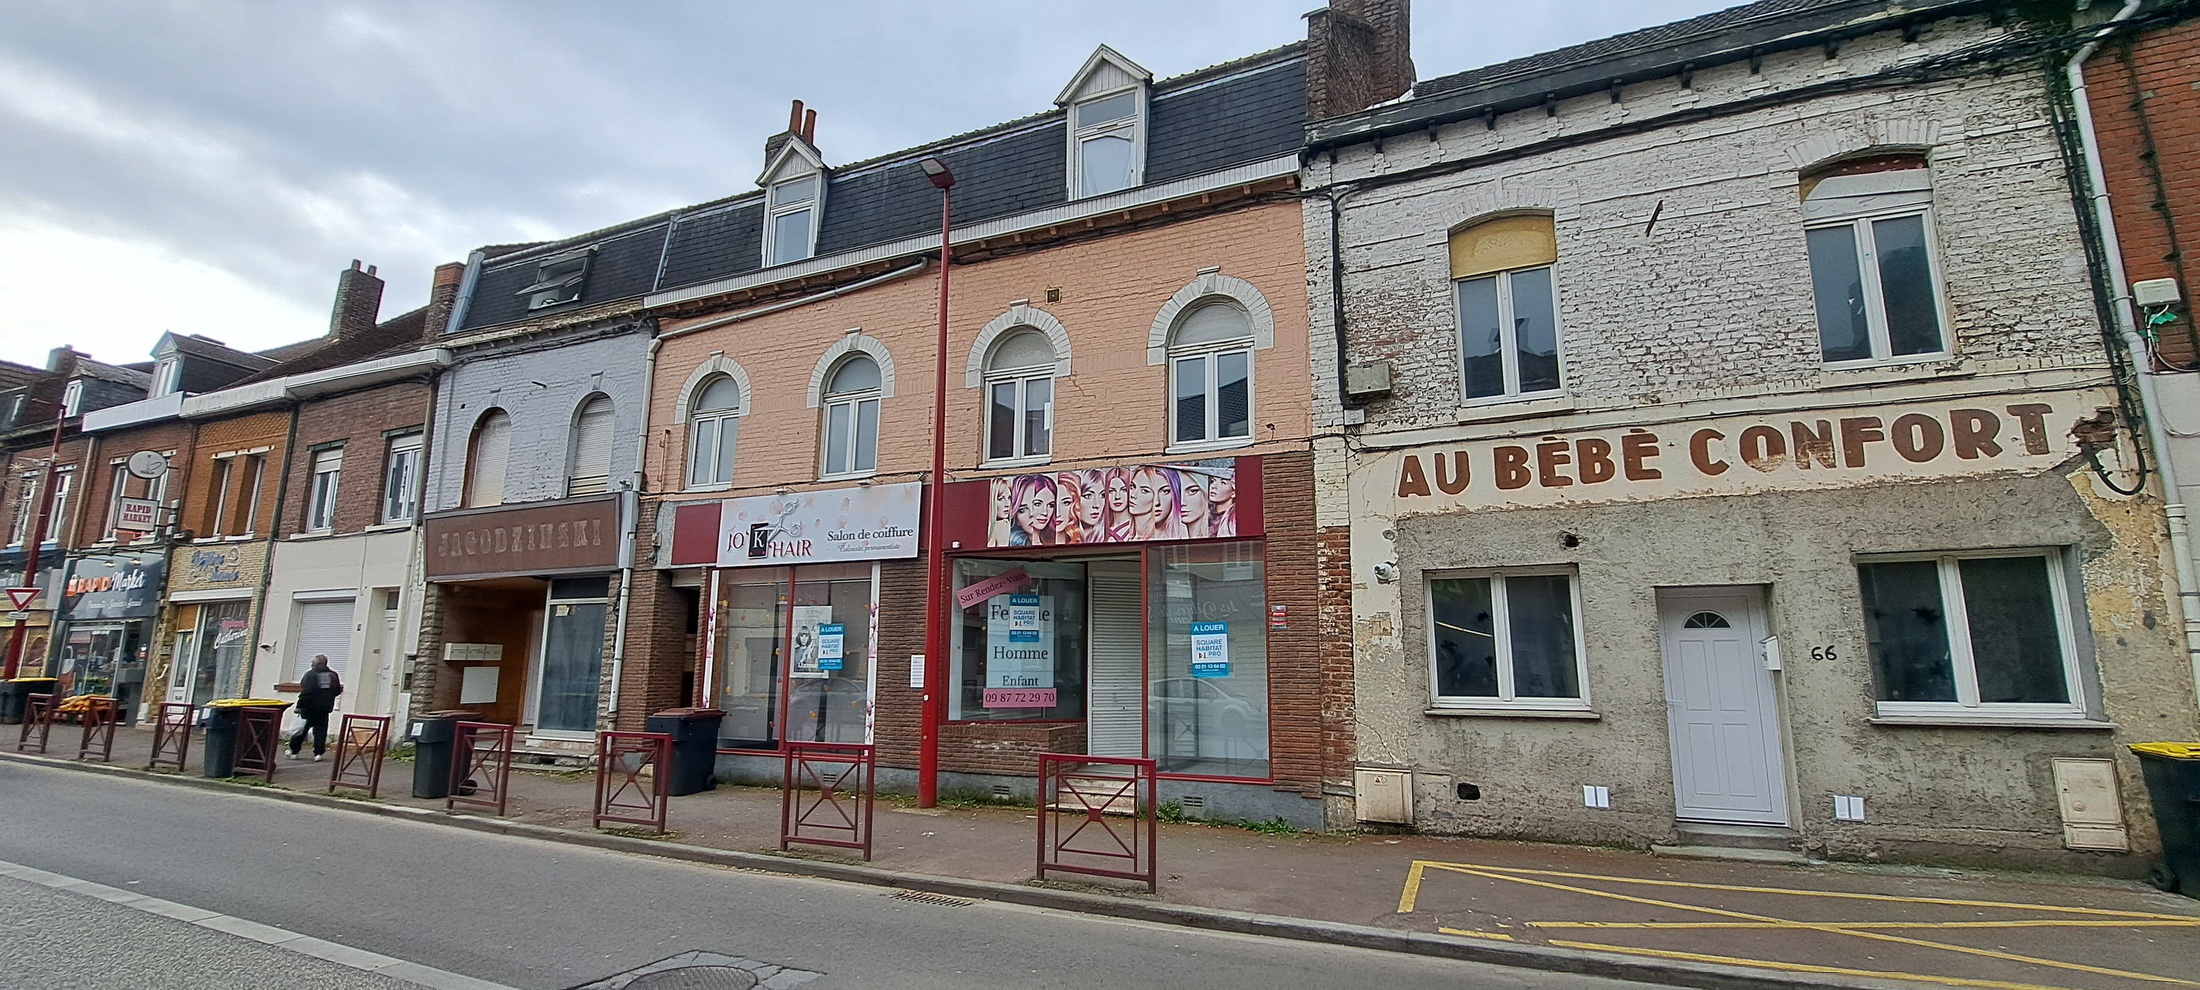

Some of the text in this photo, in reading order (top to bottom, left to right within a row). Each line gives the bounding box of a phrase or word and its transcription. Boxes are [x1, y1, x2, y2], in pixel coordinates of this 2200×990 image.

[1398, 450, 1471, 497] AU
[1689, 403, 2054, 476] CONFORT
[125, 503, 152, 514] RAPID
[122, 512, 152, 524] MARKET
[437, 519, 602, 558] JAGODZINSKI
[827, 526, 914, 542] Salon de coiffure
[76, 569, 145, 594] RAPID Market
[960, 592, 974, 604] Sur
[1200, 624, 1224, 632] LOUER
[993, 646, 1049, 660] Homme
[1811, 644, 1838, 661] 66
[1002, 675, 1039, 687] Enfant
[985, 692, 1055, 703] 09 87 72 29 70
